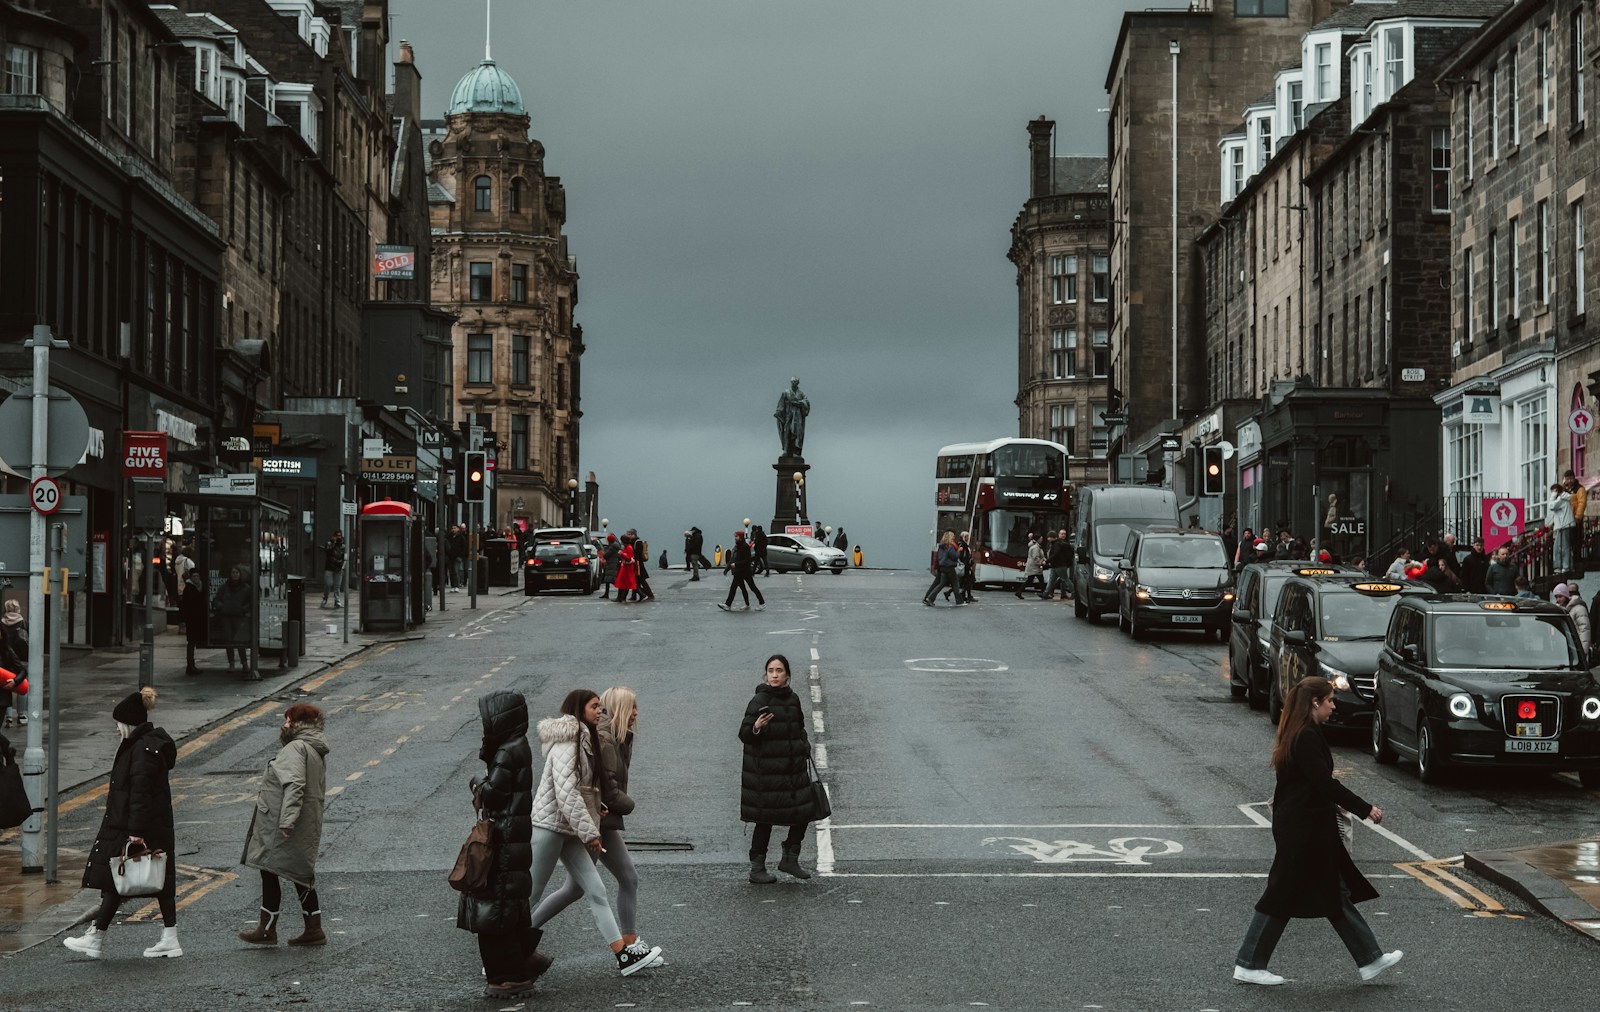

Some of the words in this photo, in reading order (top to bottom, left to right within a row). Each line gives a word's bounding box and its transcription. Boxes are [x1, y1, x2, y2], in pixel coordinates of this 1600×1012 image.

[379, 256, 409, 271] SOLD
[425, 432, 440, 442] M
[129, 447, 160, 458] FIVE
[125, 458, 164, 469] GUYS
[263, 459, 302, 470] SCOTTISH
[366, 459, 384, 469] TO
[388, 460, 413, 469] LET
[35, 487, 57, 503] 20
[1331, 523, 1365, 534] SALE
[1511, 741, 1532, 752] LO18
[1533, 741, 1552, 752] XDZ
